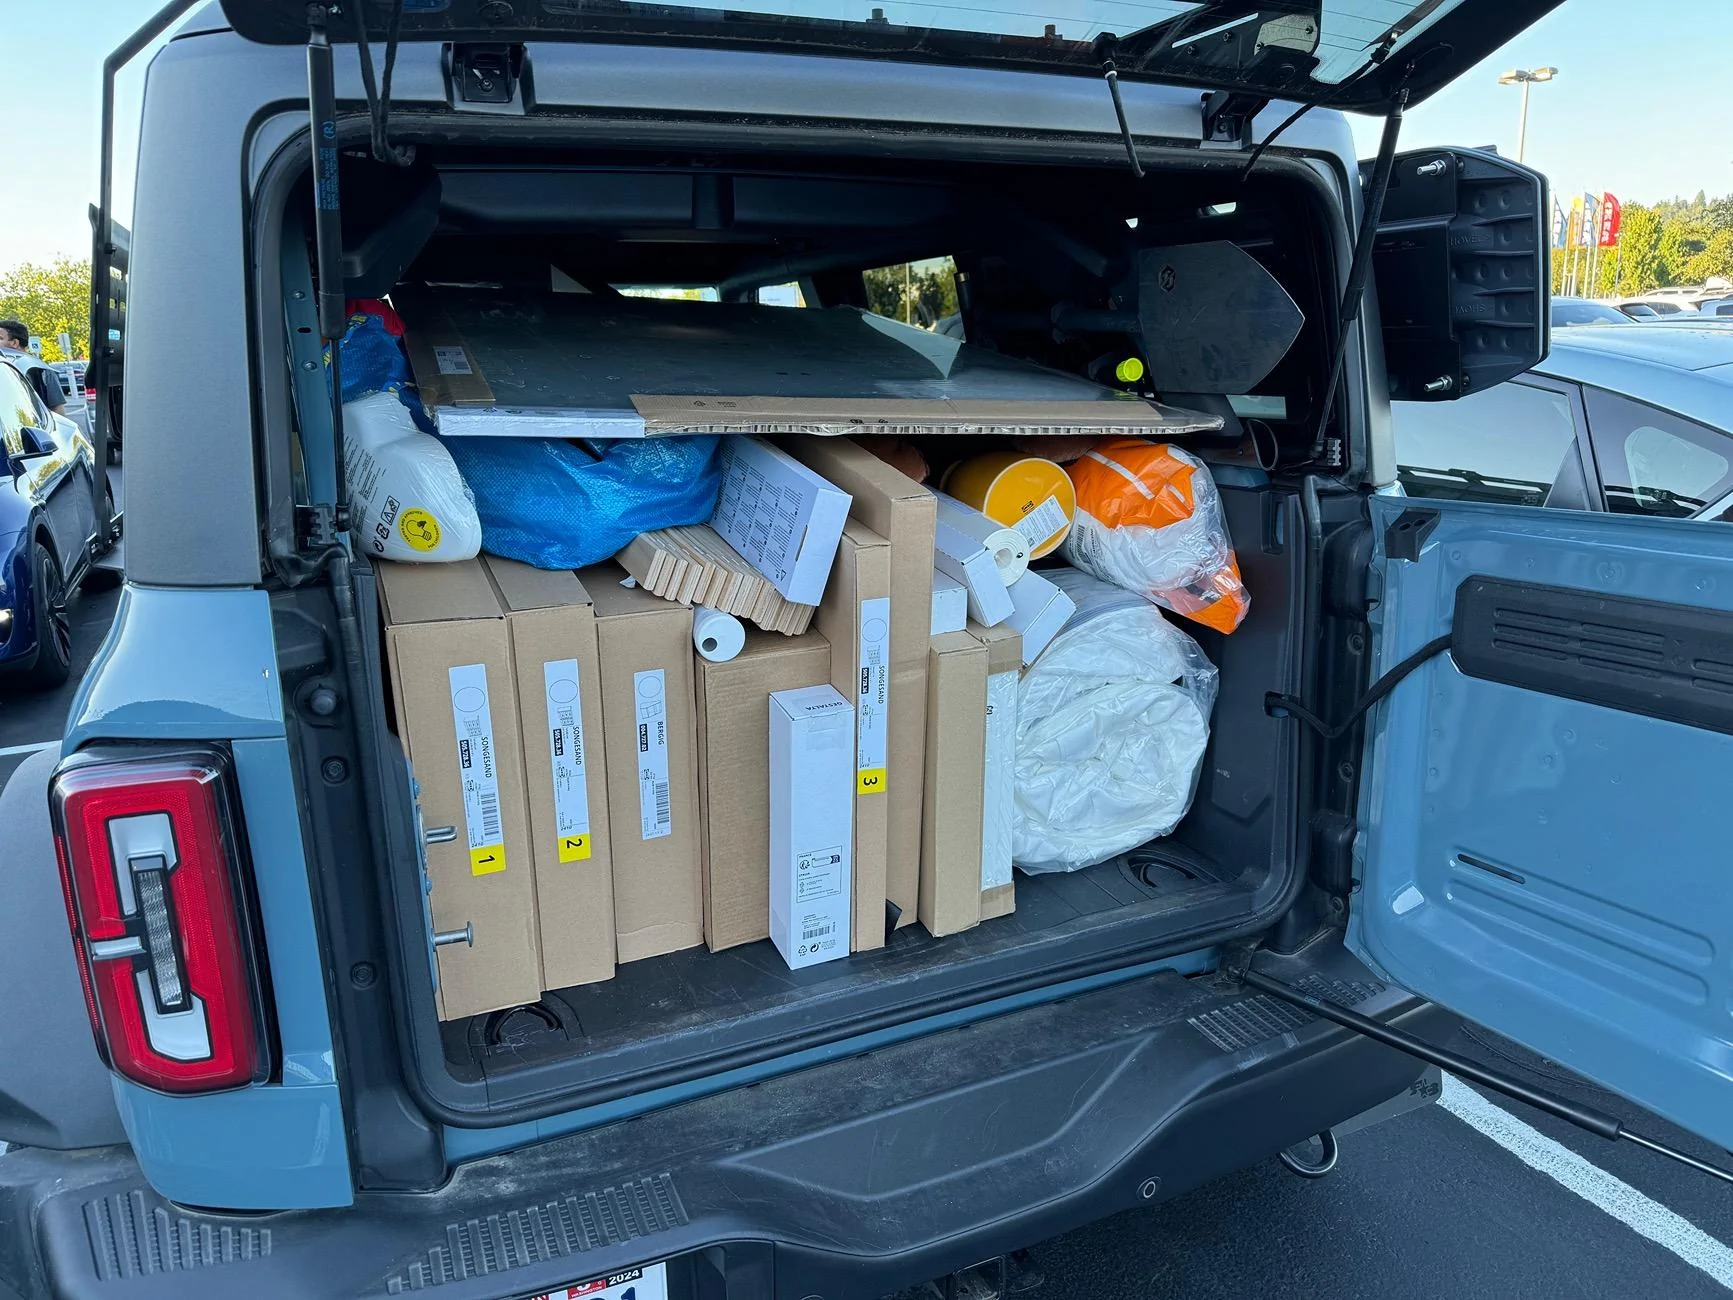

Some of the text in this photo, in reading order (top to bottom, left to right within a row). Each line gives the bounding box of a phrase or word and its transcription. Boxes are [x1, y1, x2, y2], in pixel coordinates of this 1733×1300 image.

[805, 701, 843, 711] GESTALTA
[572, 726, 582, 766] SONGESAND
[481, 736, 492, 778] SONGESAND
[864, 777, 878, 786] 3
[566, 838, 583, 849] 2
[478, 855, 496, 864] 1
[608, 1269, 640, 1286] 2024
